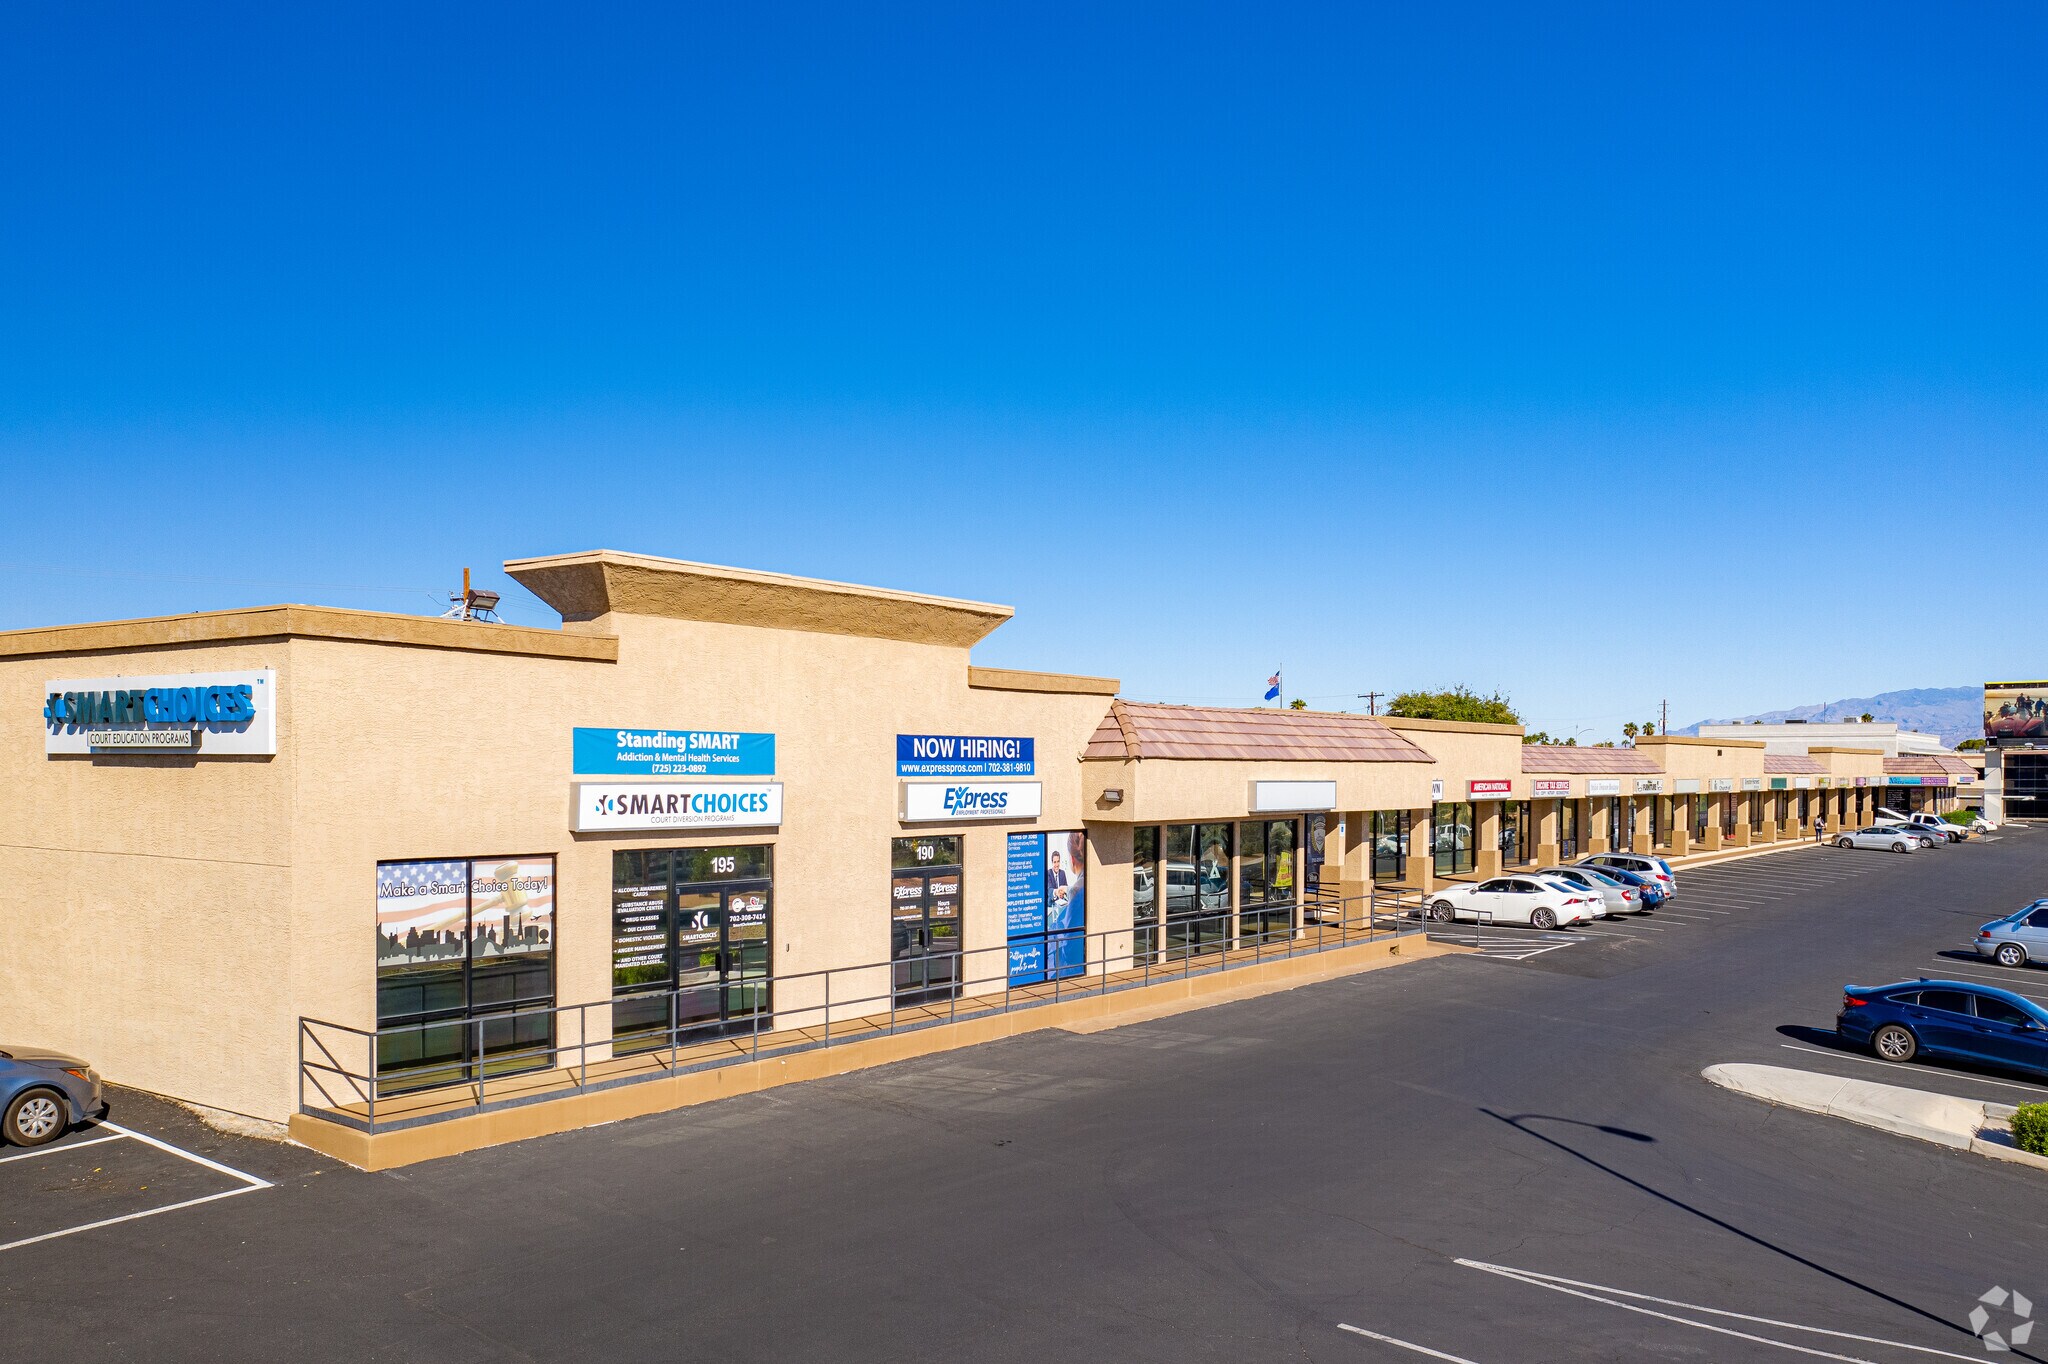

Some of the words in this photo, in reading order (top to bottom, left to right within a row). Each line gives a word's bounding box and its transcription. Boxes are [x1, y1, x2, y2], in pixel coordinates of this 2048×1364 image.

[63, 685, 252, 723] SMARTCHOICES
[91, 733, 111, 744] COURT
[113, 733, 150, 744] EDUCATION
[152, 732, 189, 743] PROGRAMS
[616, 730, 686, 752] Standing
[690, 734, 740, 750] SMART
[913, 738, 955, 758] NOW
[960, 739, 1020, 759] HIRING!
[616, 752, 654, 762] Addiction
[654, 753, 660, 762] &
[661, 753, 686, 763] Mental
[688, 753, 711, 763] Health
[712, 754, 740, 763] Services
[652, 764, 671, 774] (725)
[672, 764, 707, 773] 223-0892
[901, 764, 983, 775] www.expresspros.com
[988, 762, 1031, 773] 702-381-9810
[617, 793, 768, 815] SMARTCHOICES
[673, 815, 703, 823] DIVERSION
[704, 814, 735, 822] PROGRAMS
[917, 845, 934, 860] 190
[710, 856, 735, 873] 195
[380, 882, 415, 898] Make
[419, 886, 427, 896] a
[430, 881, 466, 894] Smart
[471, 878, 508, 893] Choice
[511, 876, 548, 894] Today!
